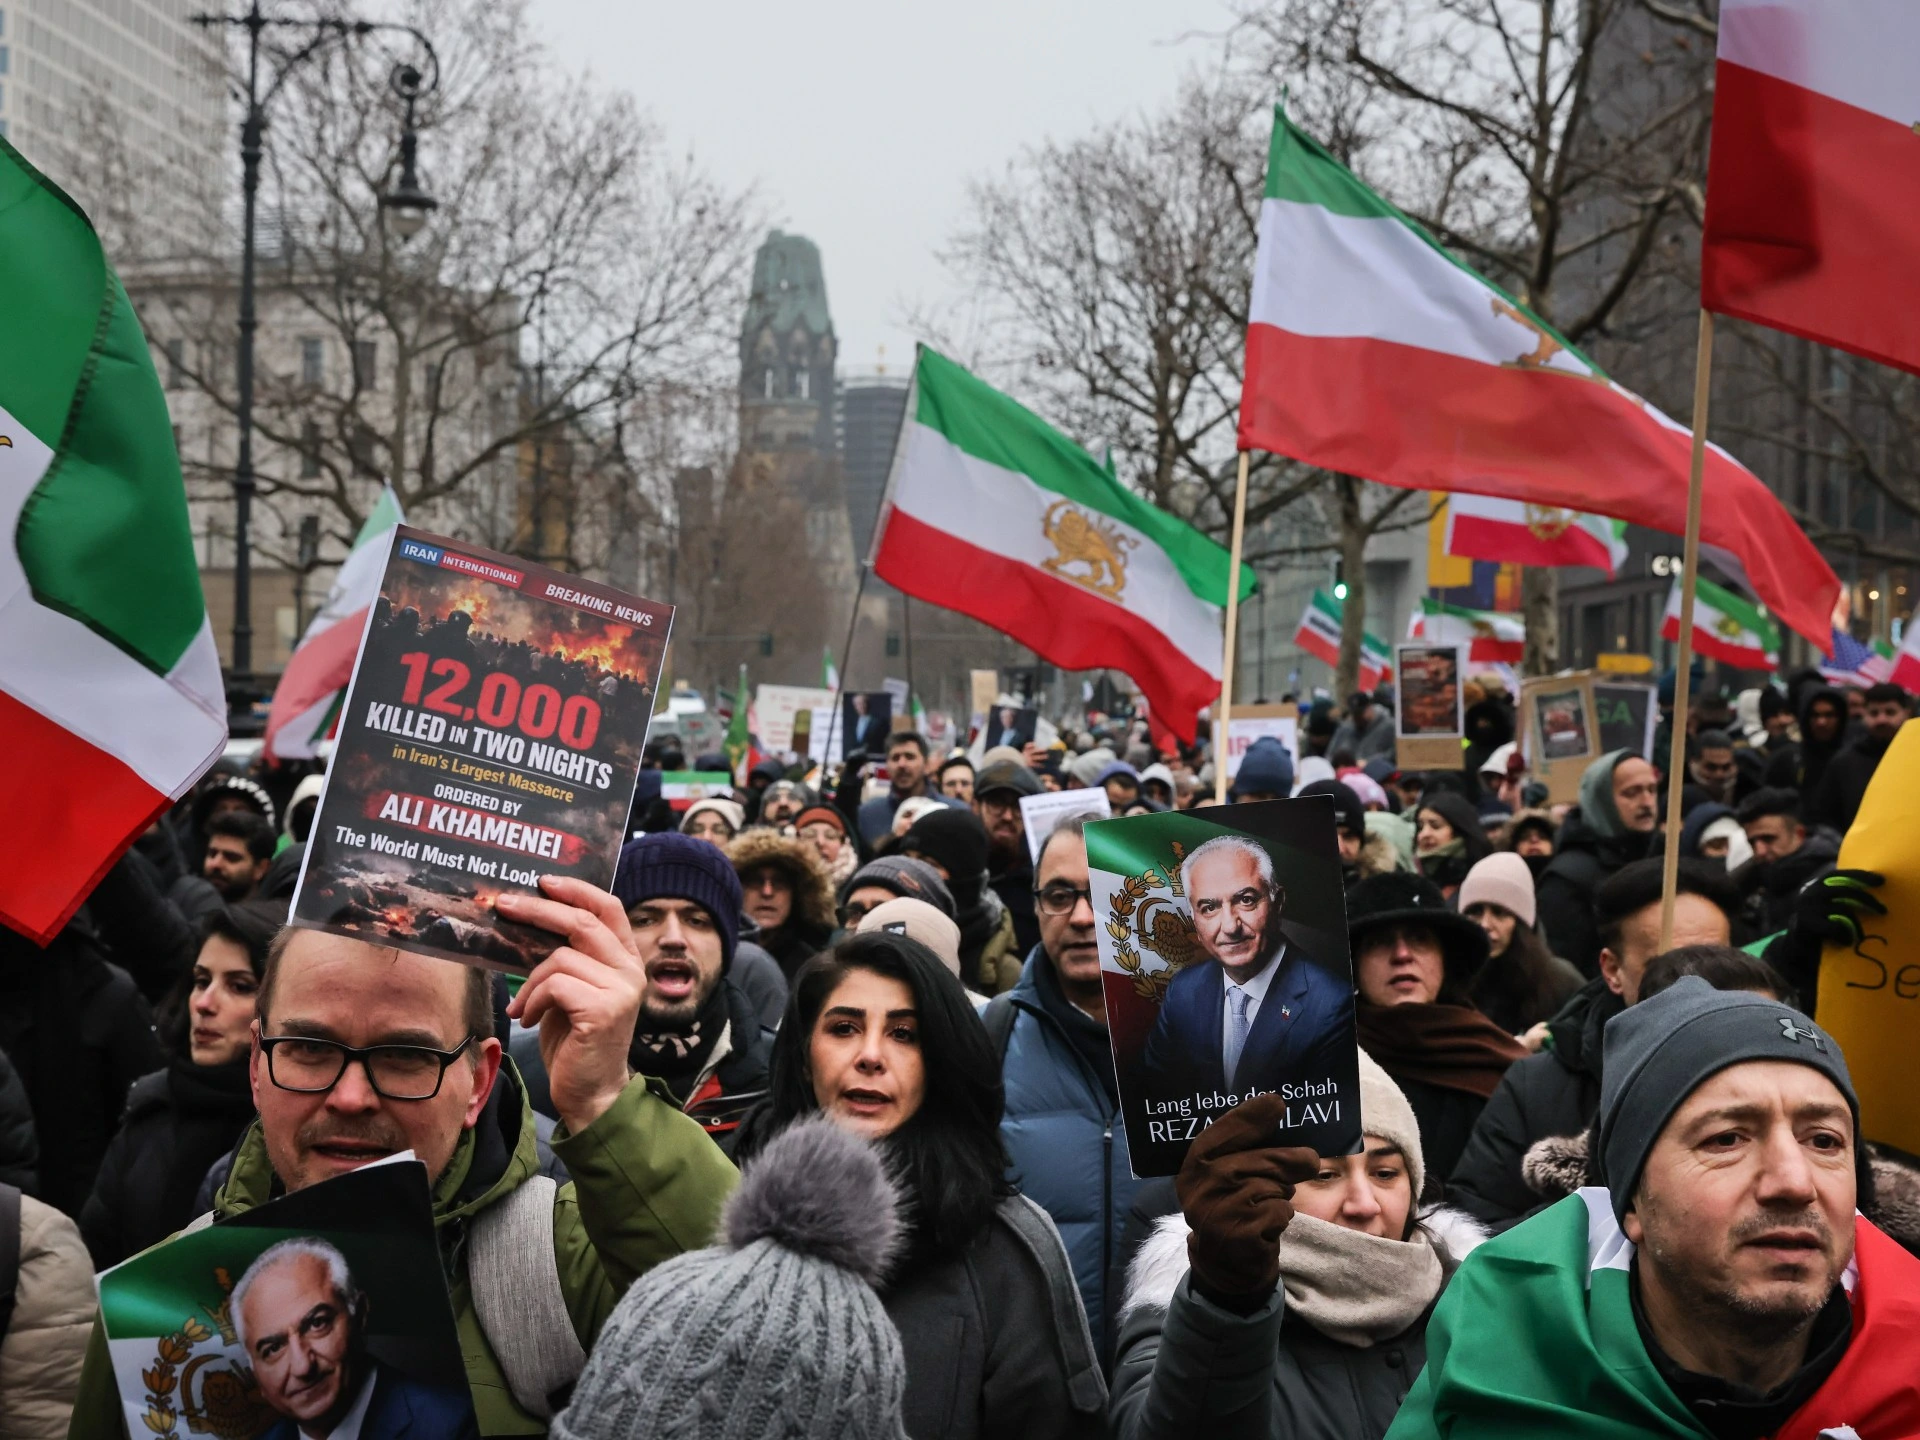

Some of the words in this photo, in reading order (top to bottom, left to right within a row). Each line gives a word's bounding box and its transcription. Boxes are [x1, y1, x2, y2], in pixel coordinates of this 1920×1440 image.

[404, 544, 437, 562] IRAN
[443, 555, 518, 584] INTERNATIONAL
[545, 583, 613, 614] BREAKING
[614, 604, 653, 627] NEWS
[400, 651, 601, 750] 12,000
[365, 701, 447, 743] KILLED
[448, 724, 469, 745] IN
[472, 726, 525, 764] TWO
[527, 741, 613, 790] NIGHTS
[392, 743, 407, 760] in
[409, 747, 449, 770] Iran's
[451, 758, 506, 785] Largest
[507, 773, 574, 803] Massacre
[433, 783, 500, 811] ORDERED
[501, 801, 523, 817] BY
[379, 793, 424, 827] ALI
[427, 803, 562, 860] KHAMENEI
[335, 825, 366, 848] The
[370, 832, 419, 860] World
[421, 844, 465, 870] Must
[467, 855, 497, 878] Not
[499, 862, 540, 888] Look
[1145, 1097, 1191, 1117] Lang
[1196, 1090, 1239, 1110] lebe
[1281, 1077, 1338, 1100] Schah
[1280, 1100, 1340, 1129] LAVI
